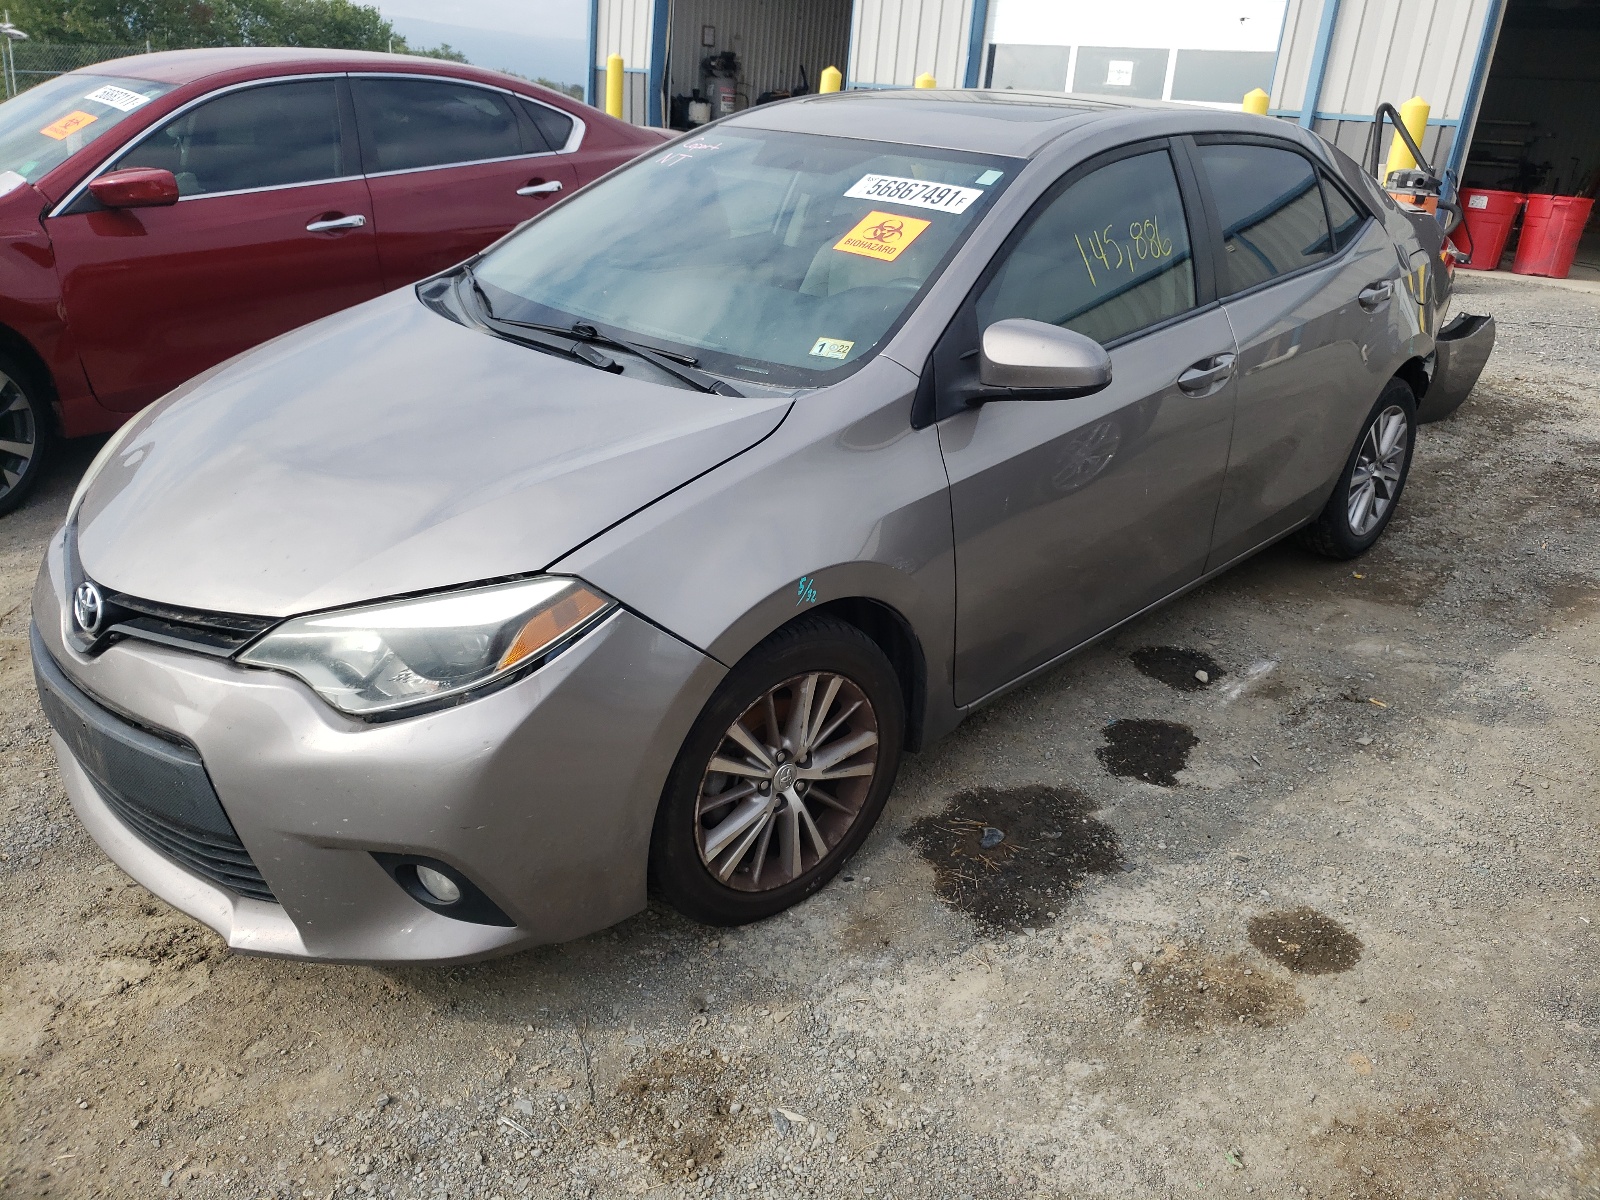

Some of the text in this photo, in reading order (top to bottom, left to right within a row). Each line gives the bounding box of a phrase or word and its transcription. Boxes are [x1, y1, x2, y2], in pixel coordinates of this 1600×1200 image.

[866, 178, 962, 207] 56867491
[844, 238, 897, 255] BIOHAZARD
[1073, 214, 1173, 288] 145,886
[818, 342, 850, 354] 1 22
